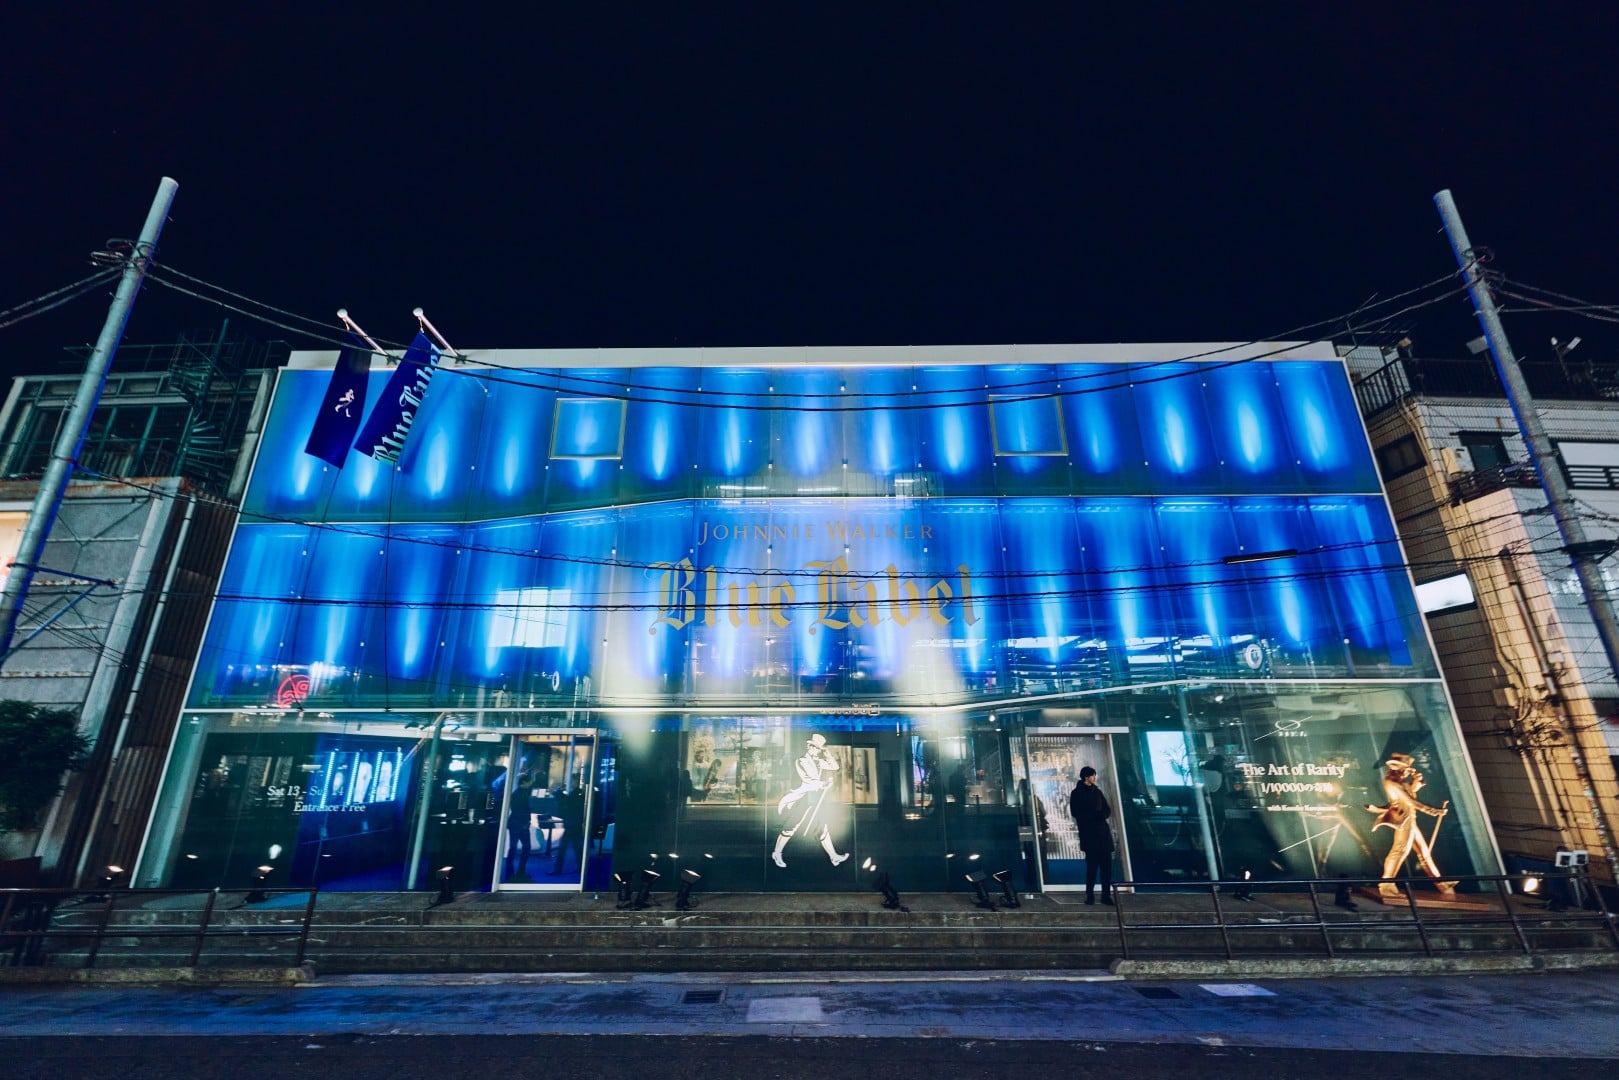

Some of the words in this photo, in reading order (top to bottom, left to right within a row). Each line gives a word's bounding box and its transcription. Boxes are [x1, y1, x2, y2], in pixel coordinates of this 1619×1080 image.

[698, 521, 816, 545] JOHNNIE
[825, 520, 934, 540] WALKER
[644, 556, 796, 636] Blue
[801, 555, 981, 636] Label
[1268, 763, 1290, 776] Art
[1291, 762, 1305, 776] of
[266, 785, 285, 796] Sat
[287, 785, 301, 796] 13
[1260, 782, 1334, 794] 1/10000の
[293, 801, 340, 812] Entrance
[341, 802, 366, 812] Free
